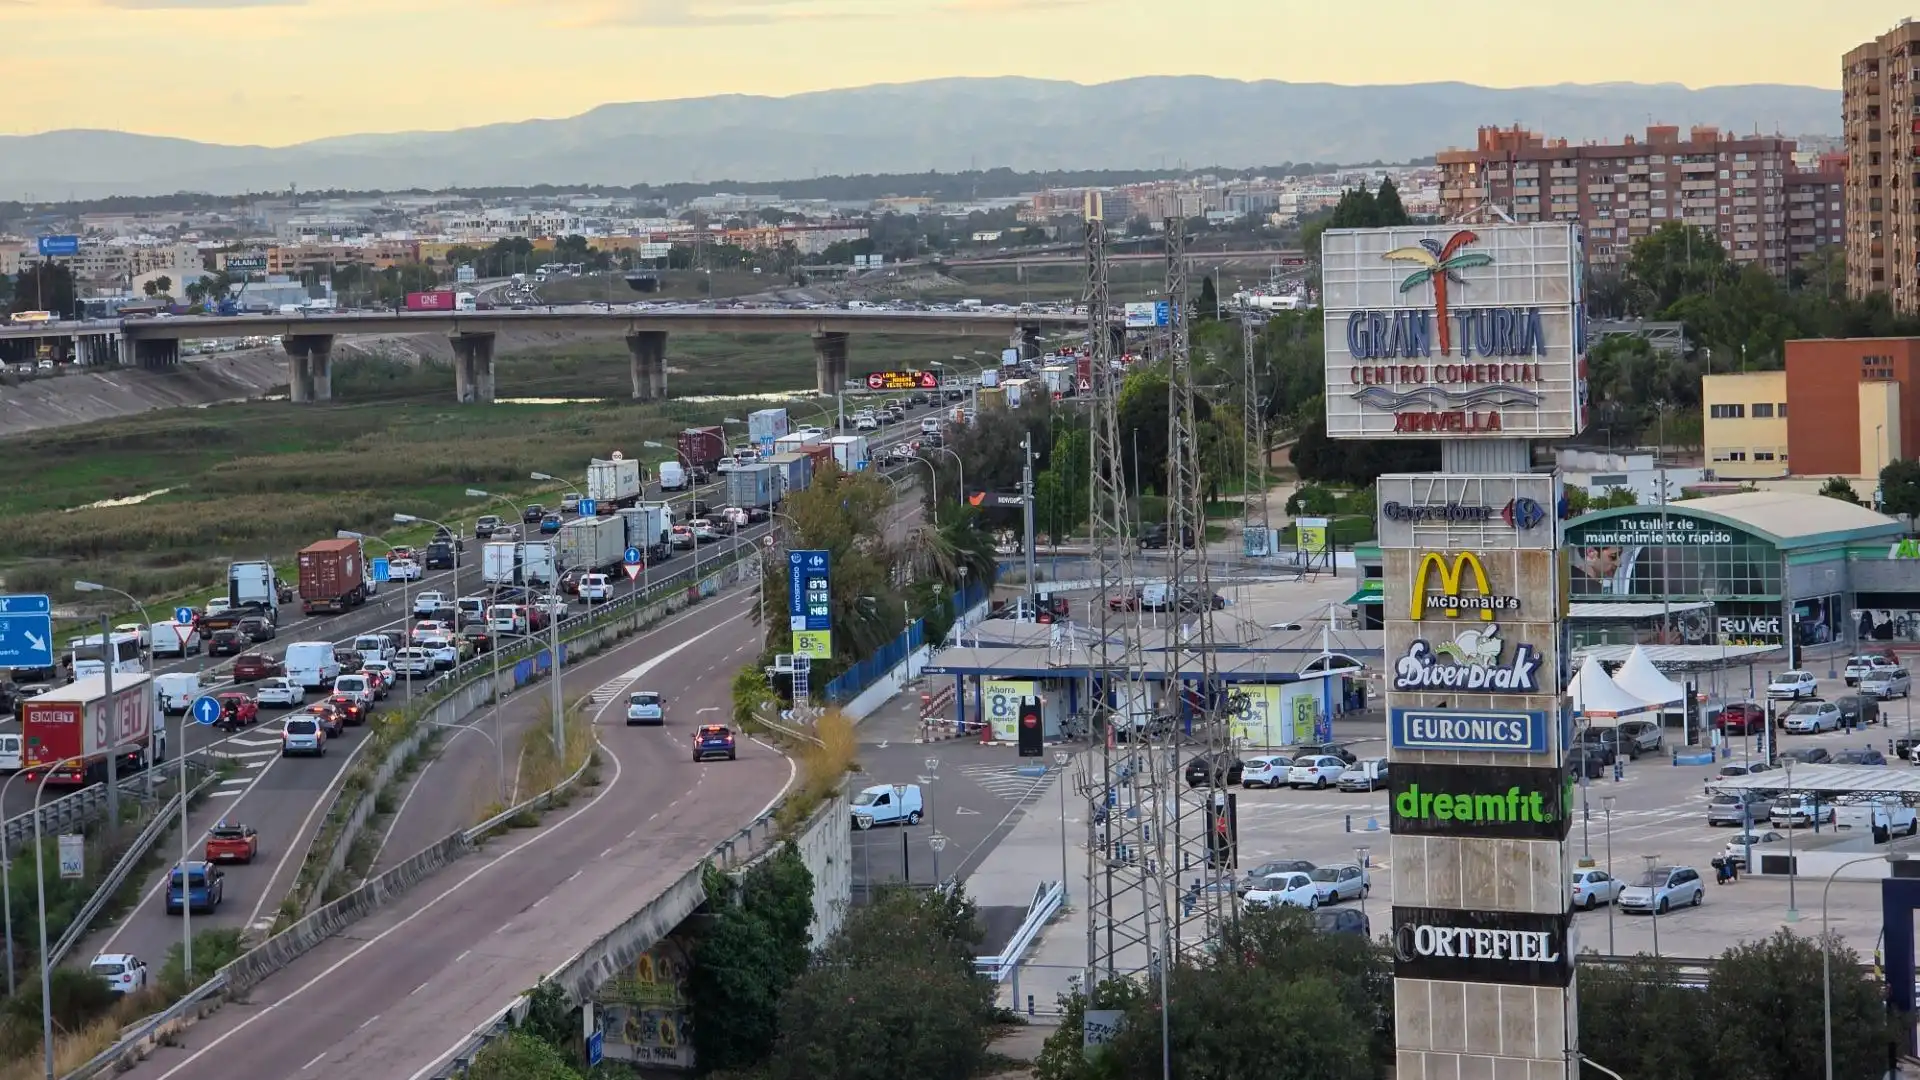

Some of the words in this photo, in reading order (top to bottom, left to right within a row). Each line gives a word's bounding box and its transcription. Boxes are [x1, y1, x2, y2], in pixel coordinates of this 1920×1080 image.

[421, 295, 438, 305] ONE
[1347, 308, 1431, 359] GRAN
[1455, 307, 1547, 357] TURIA
[1350, 365, 1426, 385] CENTRO
[1434, 363, 1545, 384] COMERCIAL
[1393, 411, 1502, 433] XIRIVELLA
[1383, 501, 1492, 521] Carrefour
[1620, 519, 1637, 530] Tu
[1640, 518, 1675, 530] taller
[1677, 518, 1694, 530] de
[1585, 531, 1685, 543] mantenimiento
[1688, 530, 1731, 545] rápido
[1426, 595, 1519, 609] McDonald's
[1718, 617, 1745, 633] Feu
[1746, 616, 1779, 633] Vert
[31, 711, 74, 723] SMET
[1412, 718, 1523, 742] EURONICS
[1396, 783, 1545, 823] dreamfit
[62, 862, 82, 870] TAXI
